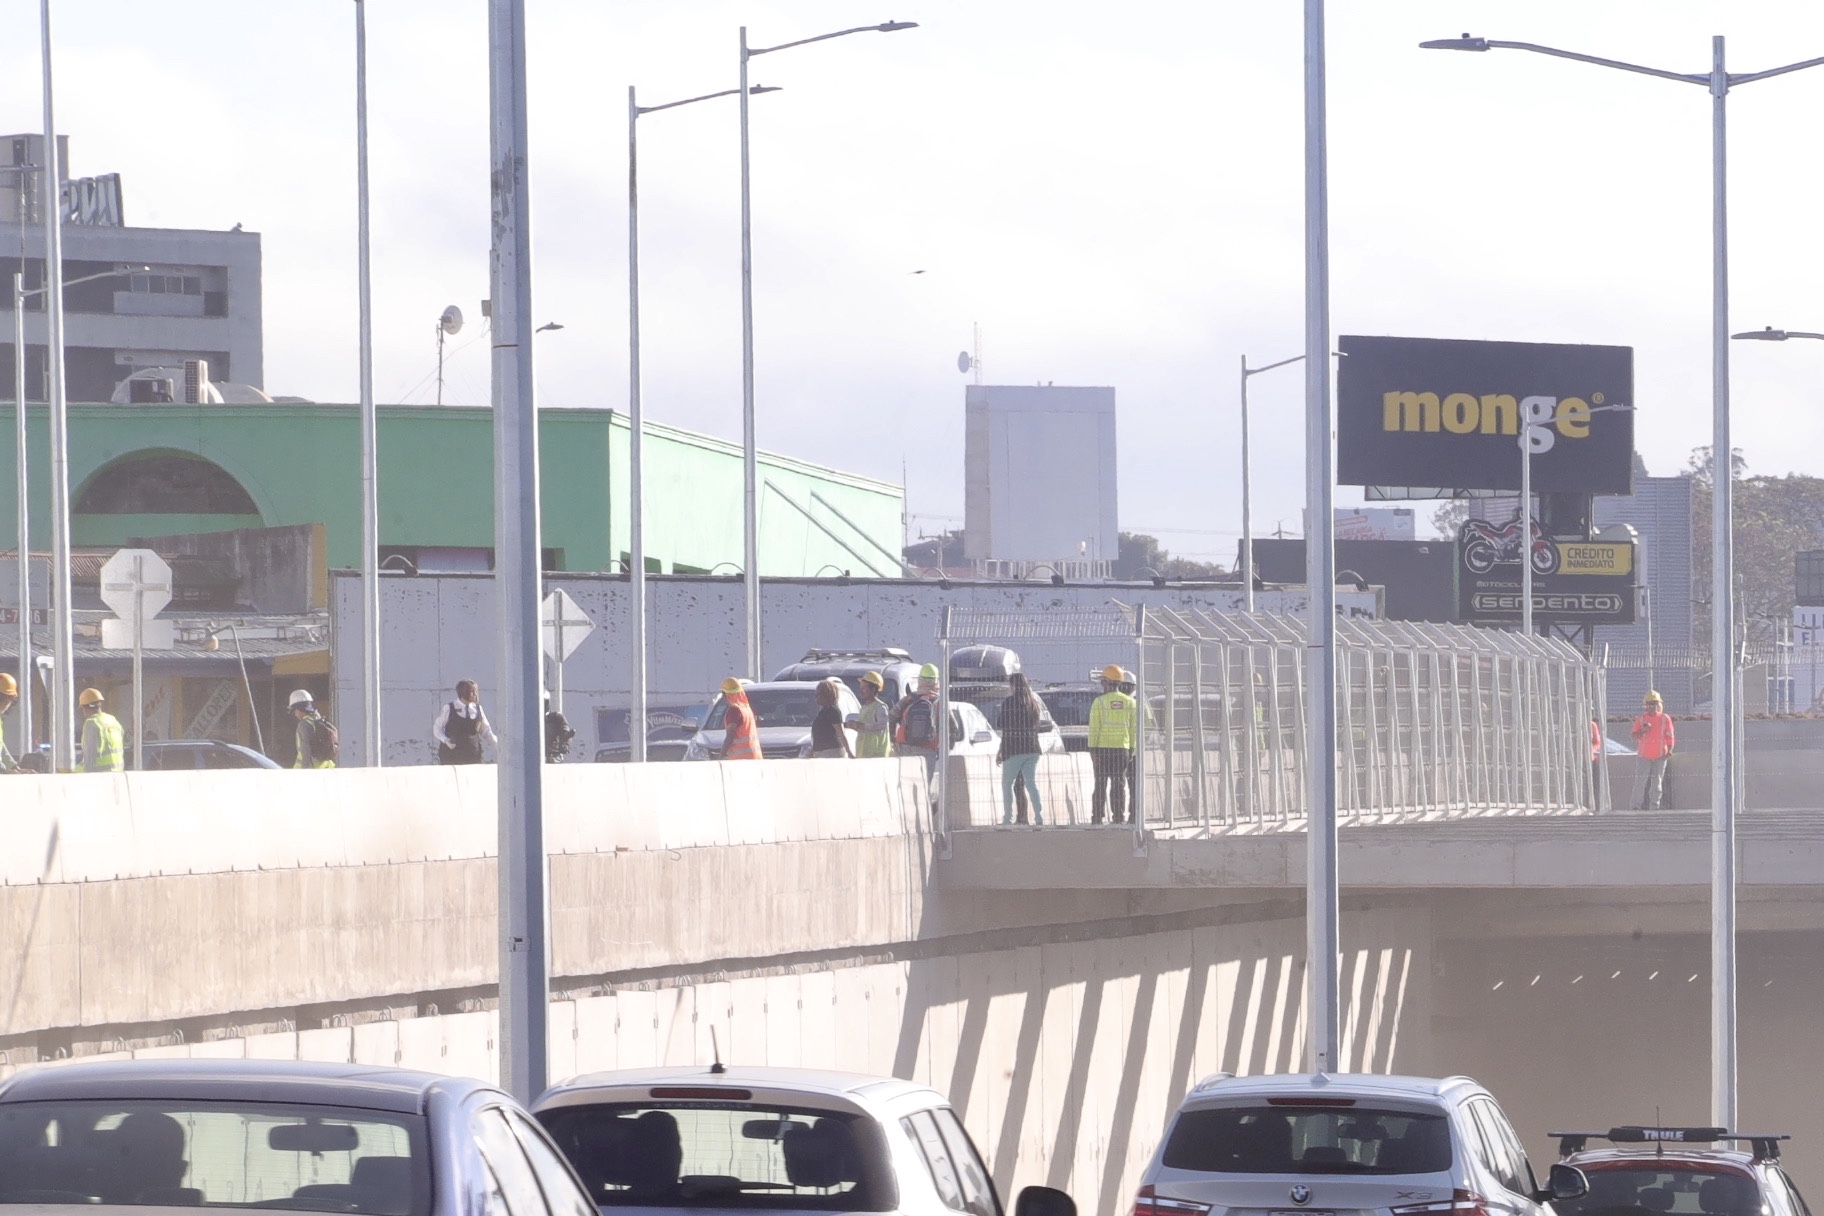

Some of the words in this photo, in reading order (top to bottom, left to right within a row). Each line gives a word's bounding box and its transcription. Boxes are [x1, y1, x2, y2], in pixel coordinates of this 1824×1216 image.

[1382, 390, 1592, 454] monge
[1567, 545, 1614, 559] CRÉDITO
[1567, 559, 1615, 569] INMEDIATO
[1643, 1130, 1684, 1141] THULE
[1395, 1191, 1433, 1200] X3
